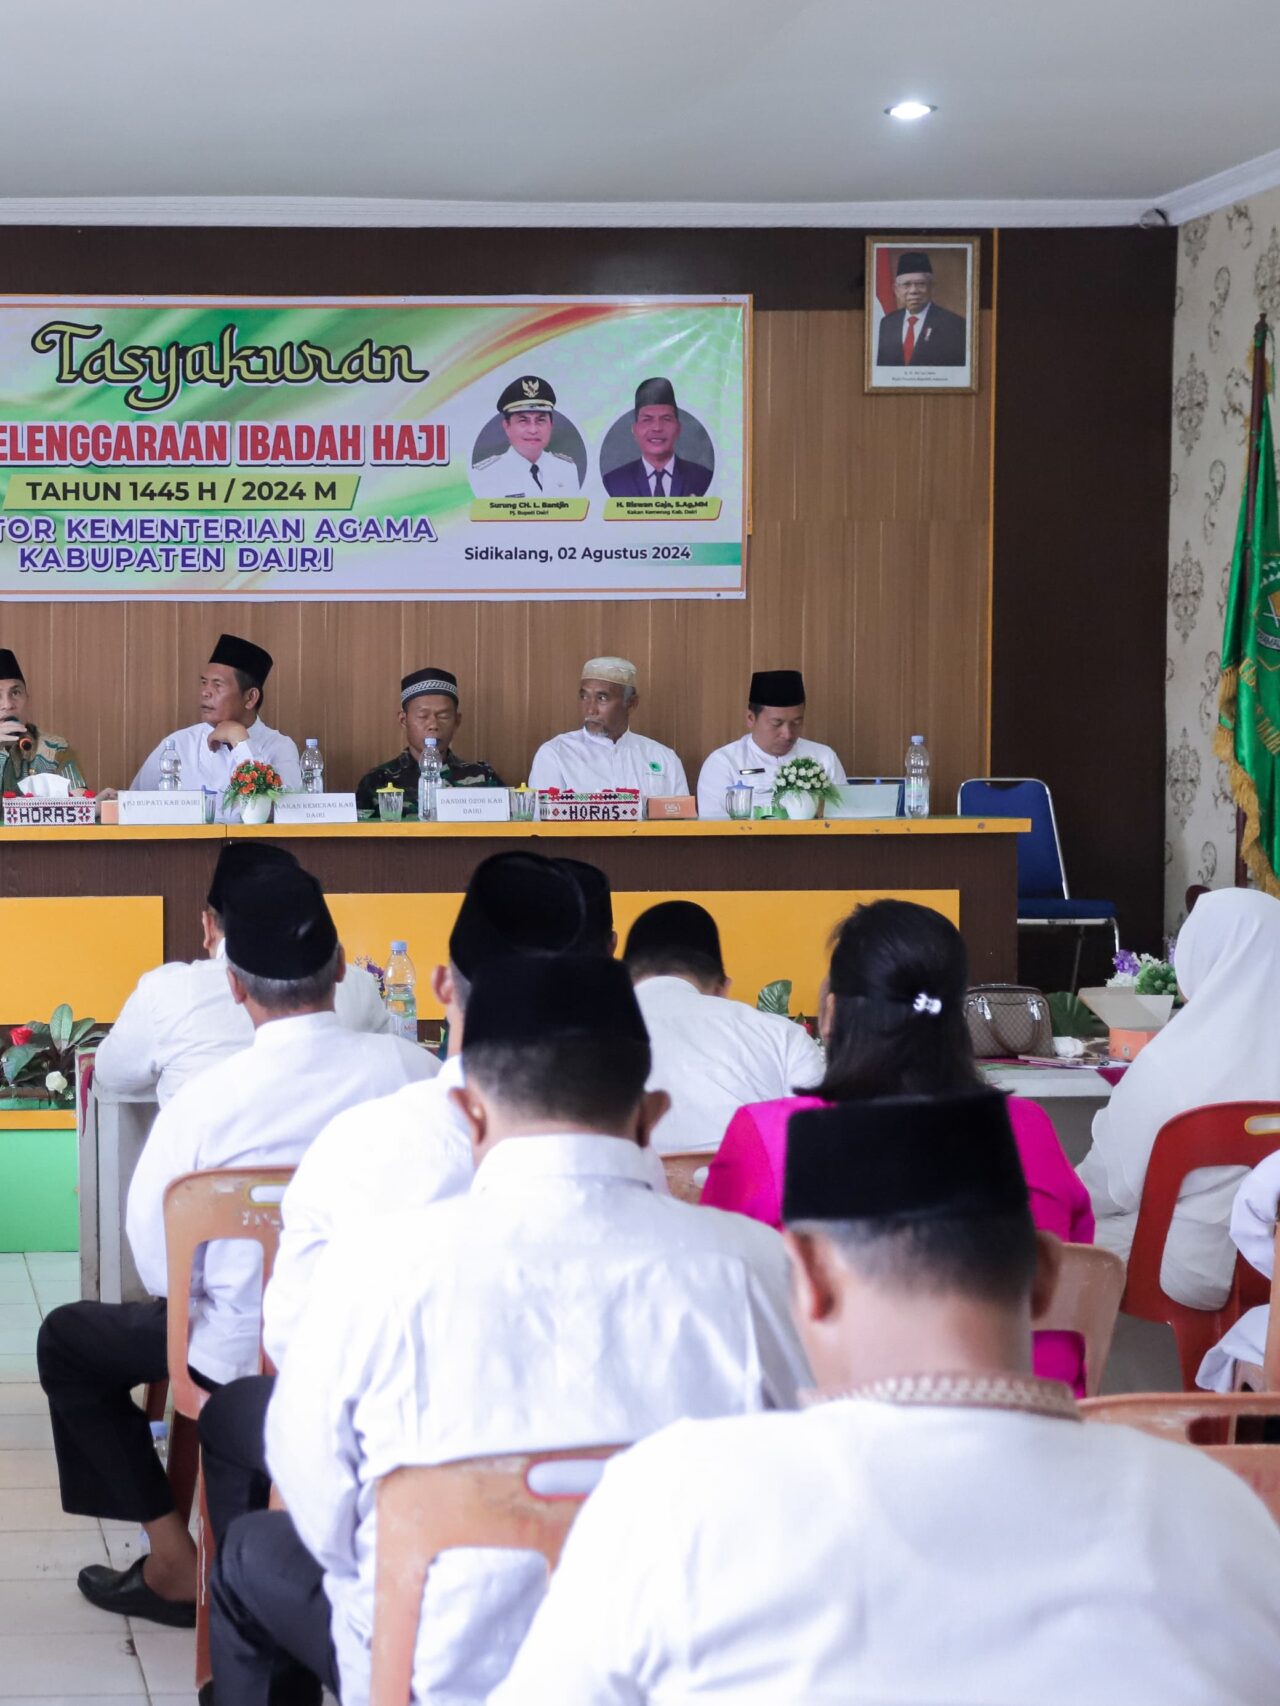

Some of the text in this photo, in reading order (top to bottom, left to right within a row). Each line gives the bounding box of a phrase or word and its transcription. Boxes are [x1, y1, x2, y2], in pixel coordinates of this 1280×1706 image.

[31, 320, 430, 412] Tasyakuran
[238, 423, 362, 462] IBADAH
[372, 423, 447, 462] HAJI
[26, 477, 337, 503] TAHUN 1445 H / 2024 M
[67, 517, 302, 540] KEMENTERIAN
[315, 517, 435, 539] AGAMA
[19, 546, 333, 569] KABUPATEN DAIRI
[464, 546, 691, 563] Sidikalang, 02 Agustus 2024
[19, 806, 77, 823] HORAS
[568, 805, 621, 820] HORAS
